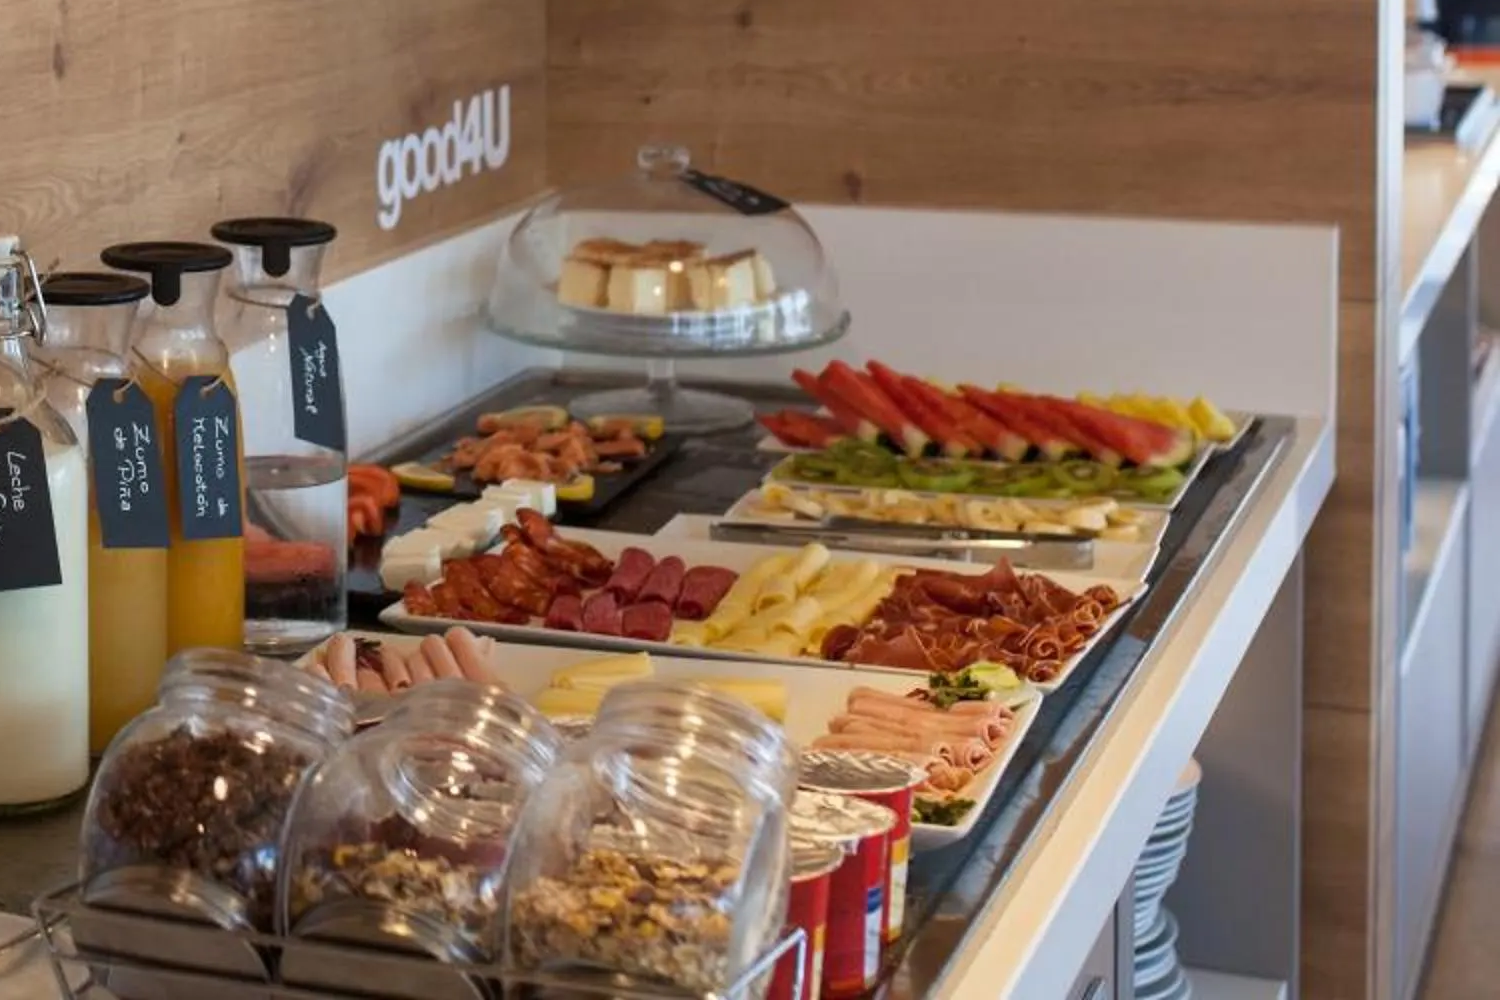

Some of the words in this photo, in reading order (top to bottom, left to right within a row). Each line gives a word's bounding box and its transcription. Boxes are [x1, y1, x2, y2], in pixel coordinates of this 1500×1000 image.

[378, 84, 510, 232] good4U
[299, 347, 318, 414] Natural
[113, 427, 128, 450] de
[132, 421, 151, 494] Zumo
[214, 416, 229, 479] Zumo
[7, 451, 31, 513] Leche
[117, 459, 135, 511] Piña
[217, 498, 229, 517] de
